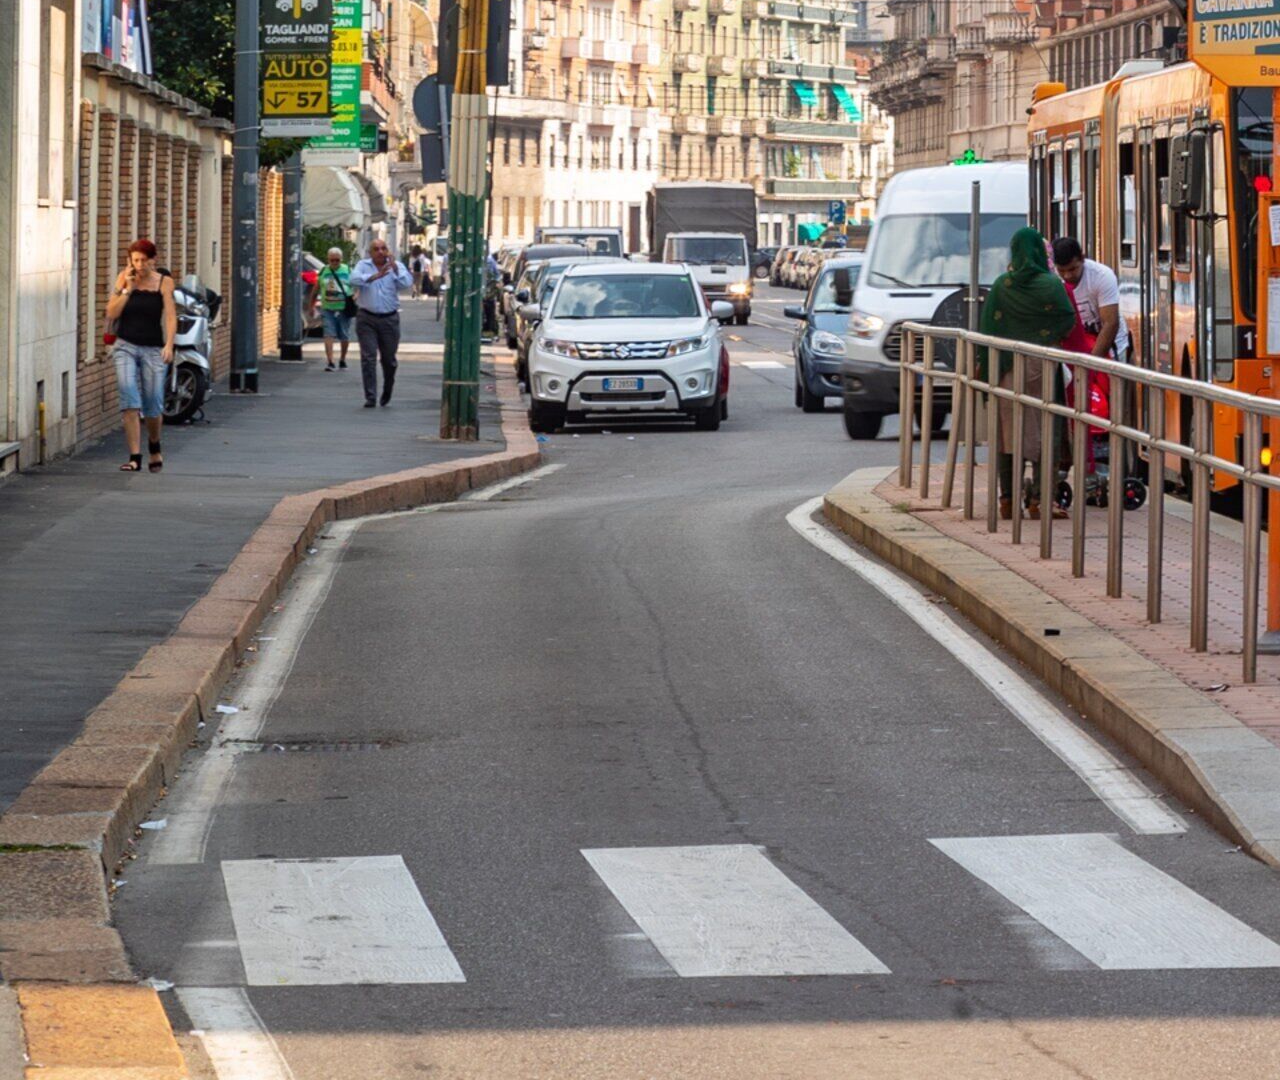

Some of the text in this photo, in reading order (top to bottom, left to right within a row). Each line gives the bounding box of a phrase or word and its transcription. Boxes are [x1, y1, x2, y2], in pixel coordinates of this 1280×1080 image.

[265, 23, 329, 35] TAGLIANDI
[1199, 23, 1207, 44] È
[265, 36, 297, 44] GOMME
[265, 60, 328, 77] AUTO
[297, 91, 322, 108] 57
